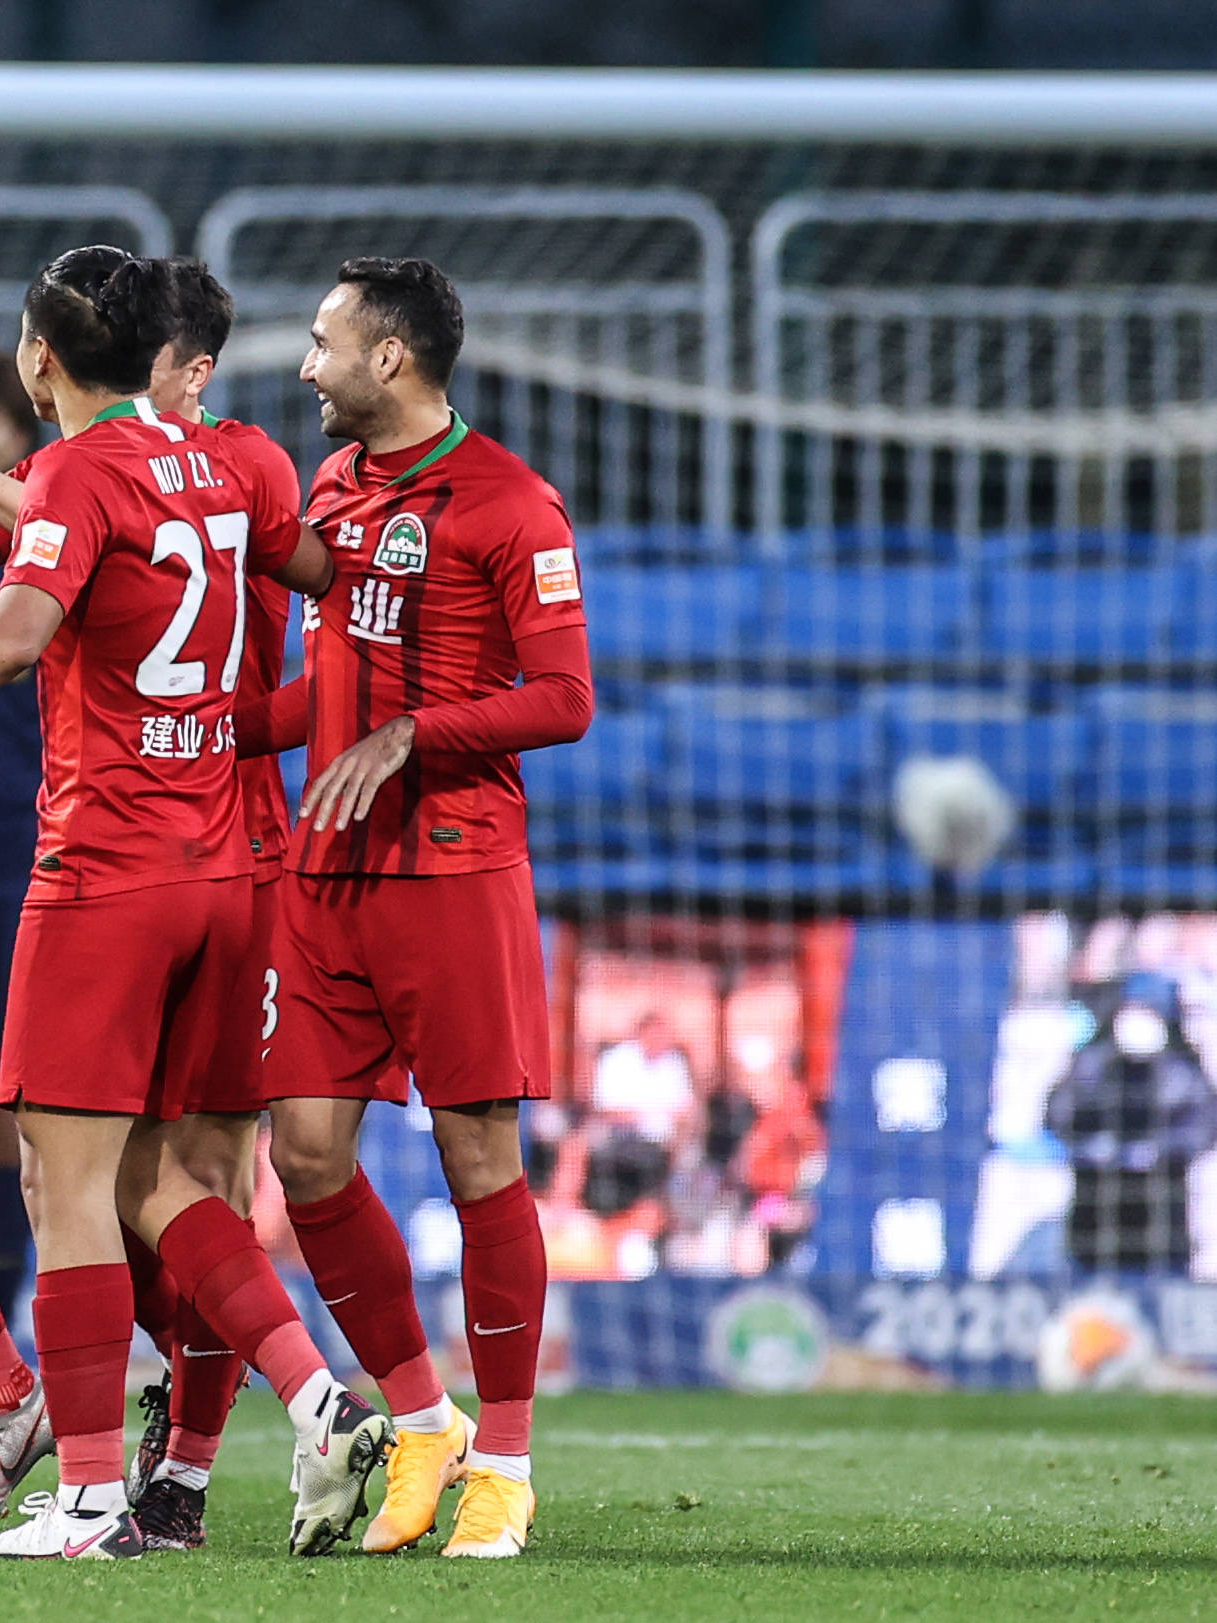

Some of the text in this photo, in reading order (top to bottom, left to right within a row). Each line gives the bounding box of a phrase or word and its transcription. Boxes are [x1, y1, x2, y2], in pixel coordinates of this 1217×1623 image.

[147, 454, 185, 495] NIU
[135, 510, 249, 697] 27
[857, 1282, 1049, 1361] 2020
